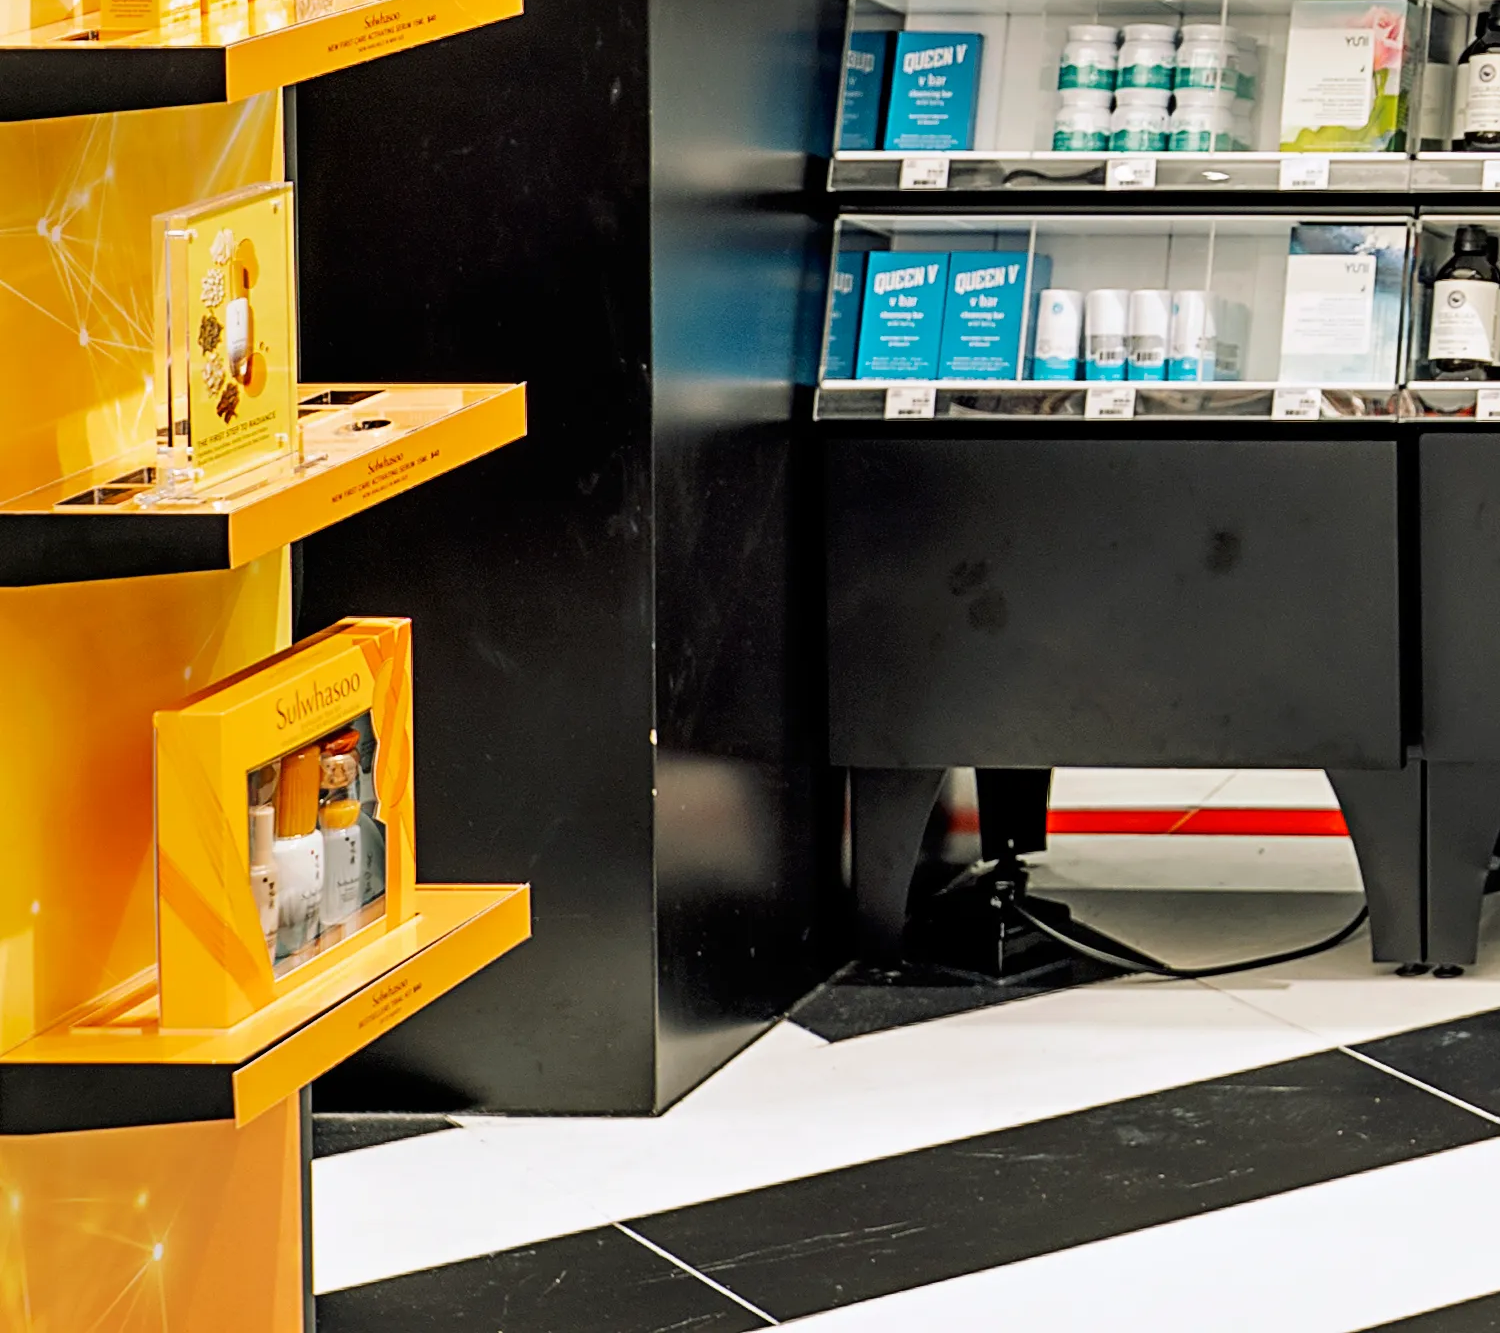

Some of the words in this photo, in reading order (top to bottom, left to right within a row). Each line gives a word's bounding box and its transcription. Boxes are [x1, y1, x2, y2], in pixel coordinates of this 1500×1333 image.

[903, 48, 953, 74] QUEEN
[953, 44, 969, 65] V
[927, 75, 947, 86] bar
[873, 265, 926, 295] QUEEN
[926, 263, 940, 284] V
[954, 265, 1006, 295] QUEEN
[1006, 263, 1020, 284] V
[899, 294, 918, 308] bar
[979, 294, 998, 308] bar
[276, 672, 361, 730] Sulwhasoo
